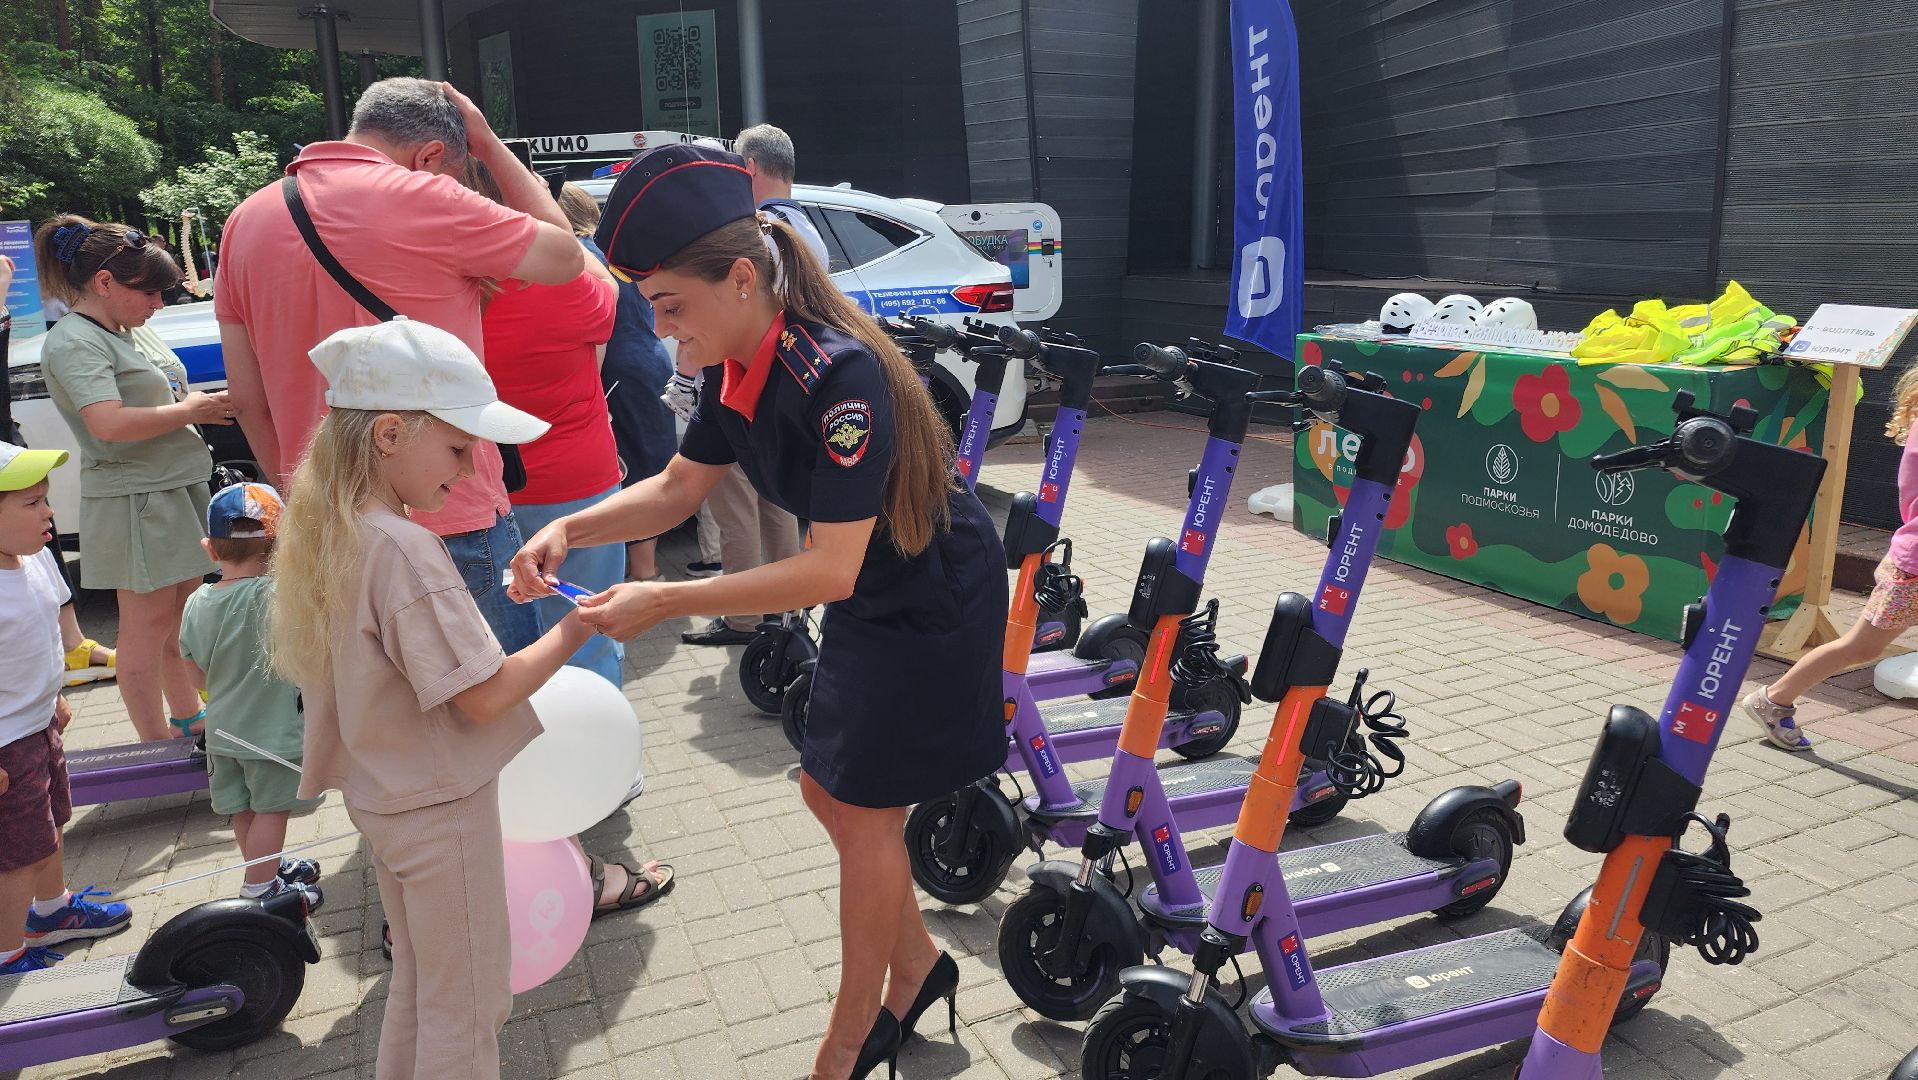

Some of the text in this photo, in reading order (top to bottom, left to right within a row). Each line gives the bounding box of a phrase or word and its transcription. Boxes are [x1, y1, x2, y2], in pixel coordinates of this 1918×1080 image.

[872, 288, 949, 298] ТЕЛЕФОН ДОВЕРИЯ
[880, 300, 900, 309] (495)
[936, 297, 946, 305] 66
[823, 402, 867, 424] ПОЛИЦИЯ
[829, 412, 864, 431] РОССИЯ
[963, 417, 979, 456] ЮРЕНТ
[840, 454, 860, 467] МВД
[1048, 437, 1065, 480] ЮРЕНТ
[1193, 475, 1216, 528] ЮРЕНТ
[1461, 493, 1540, 519] ПОДМОСКОВЬЯ
[1483, 487, 1517, 502] ПАРКИ
[1592, 509, 1633, 527] ПАРКИ
[1568, 517, 1659, 545] ДОМОДЕДОВО
[1334, 522, 1364, 584] ЮРЕНТ
[1696, 617, 1743, 701] ЮРЕНТ
[1040, 750, 1054, 774] ЮРЕНТ
[1163, 842, 1176, 871] ЮРЕНТ
[1290, 953, 1306, 984] ЮРЕНТ
[1426, 966, 1475, 982] юрент
